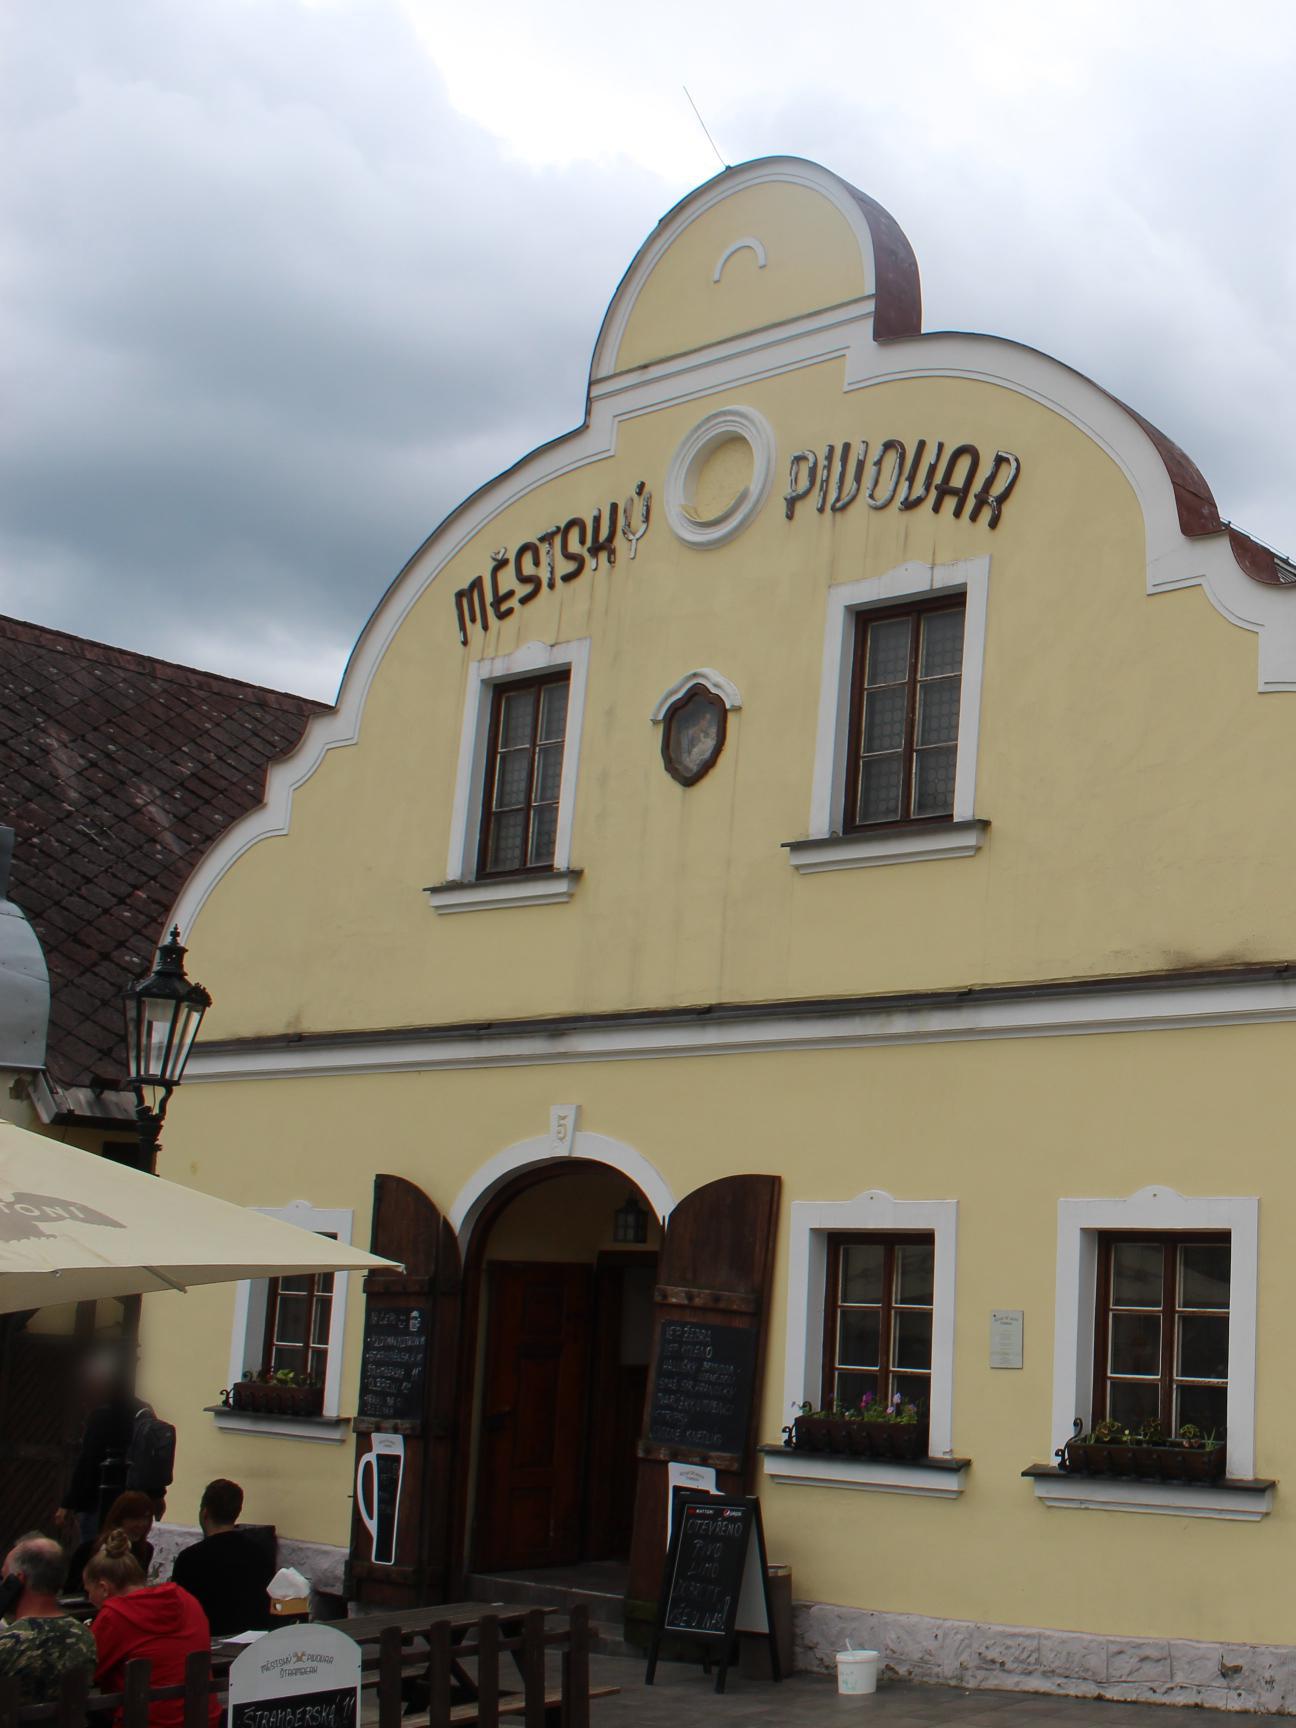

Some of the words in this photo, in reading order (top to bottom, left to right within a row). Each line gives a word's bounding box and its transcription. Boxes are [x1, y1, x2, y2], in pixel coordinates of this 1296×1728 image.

[453, 480, 653, 646] MĚSTSKÝ
[784, 438, 1022, 530] PIVOVAR
[556, 1114, 569, 1143] 5
[261, 1652, 293, 1674] MĚSTSKÝ
[306, 1653, 335, 1665] PIVOVAR
